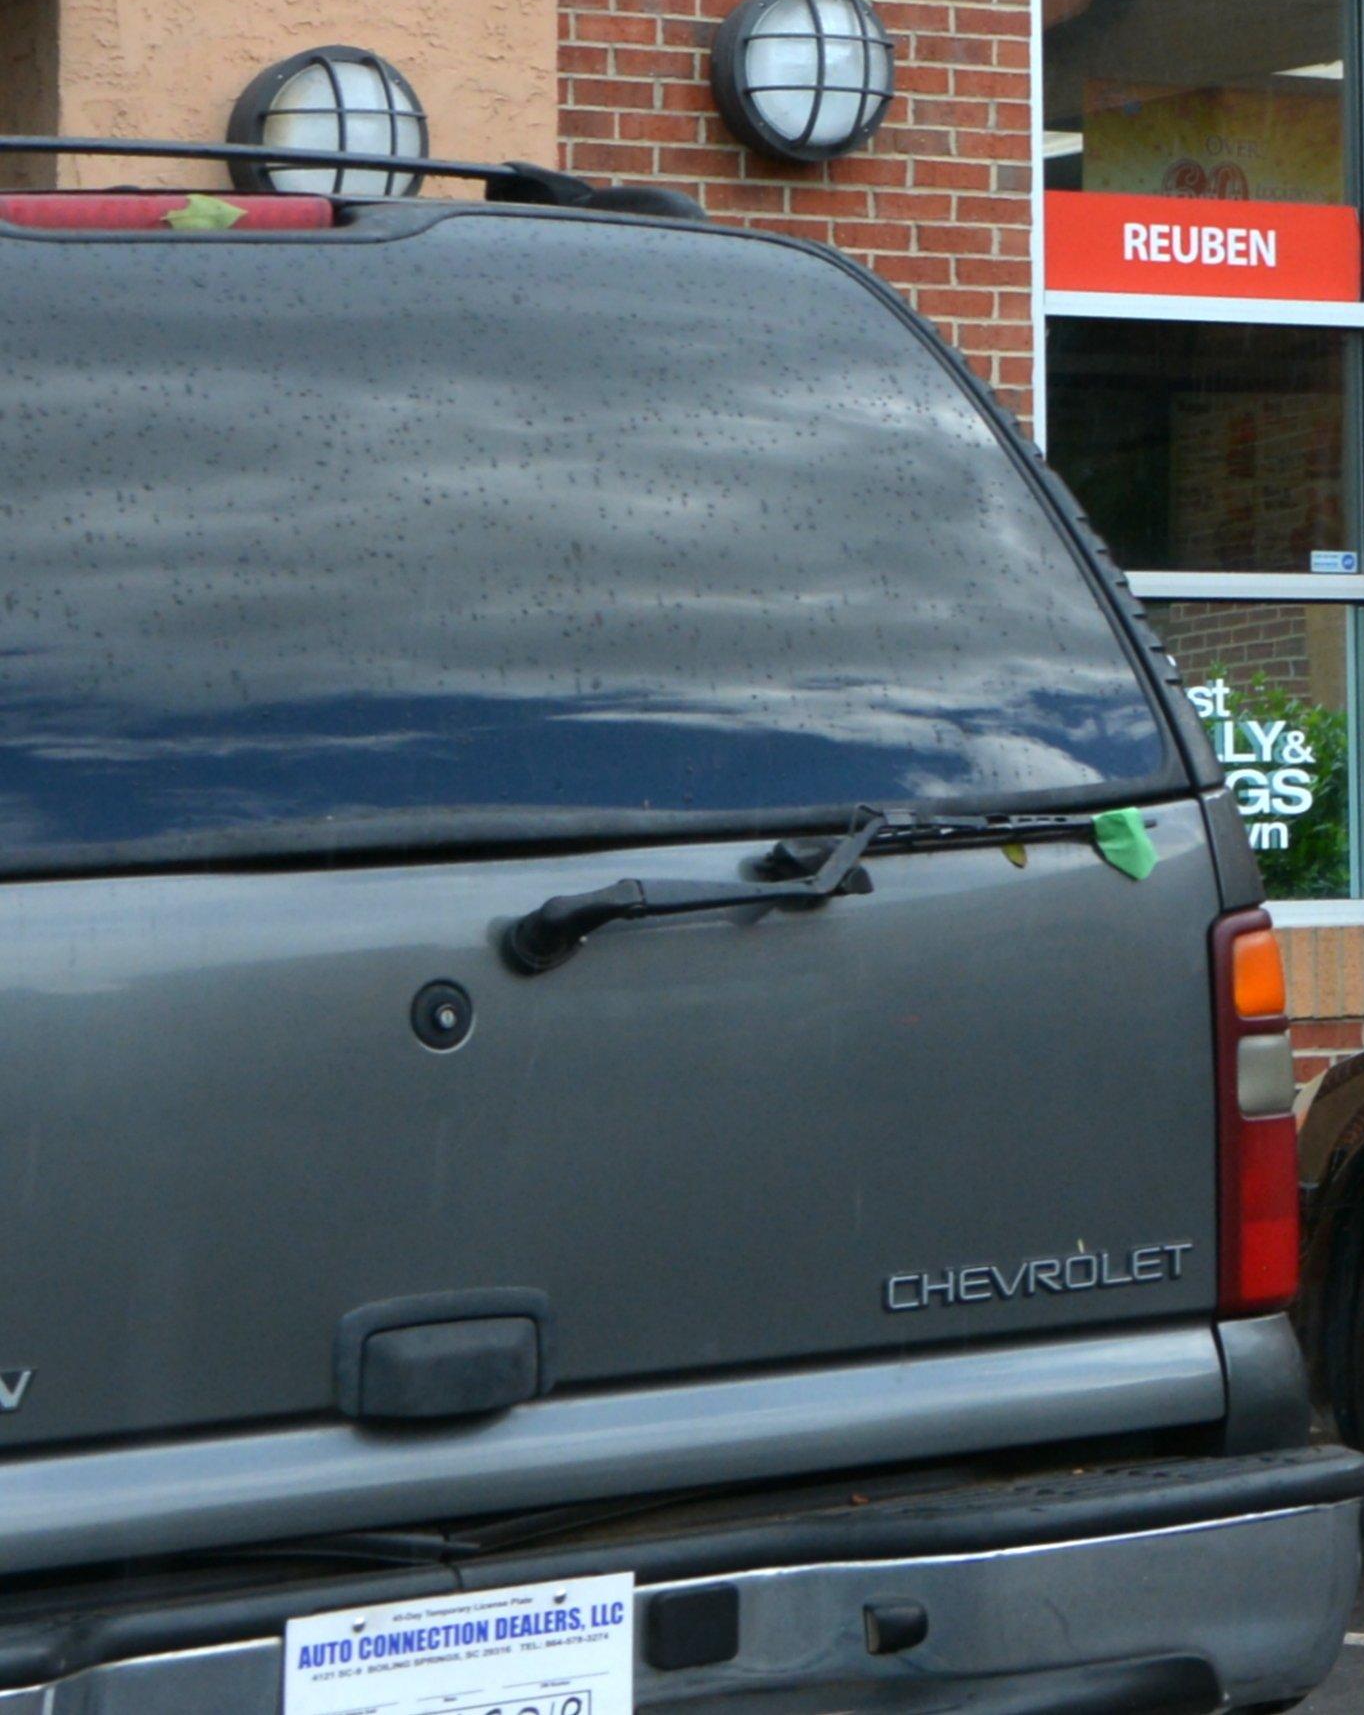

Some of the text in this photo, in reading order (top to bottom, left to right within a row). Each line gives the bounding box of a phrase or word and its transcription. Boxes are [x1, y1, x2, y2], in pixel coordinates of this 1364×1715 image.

[1122, 222, 1277, 267] REUBEN
[886, 1242, 1195, 1310] CHEVROLET
[297, 1601, 625, 1670] AUTO CONNECTION DEALERS, LLC
